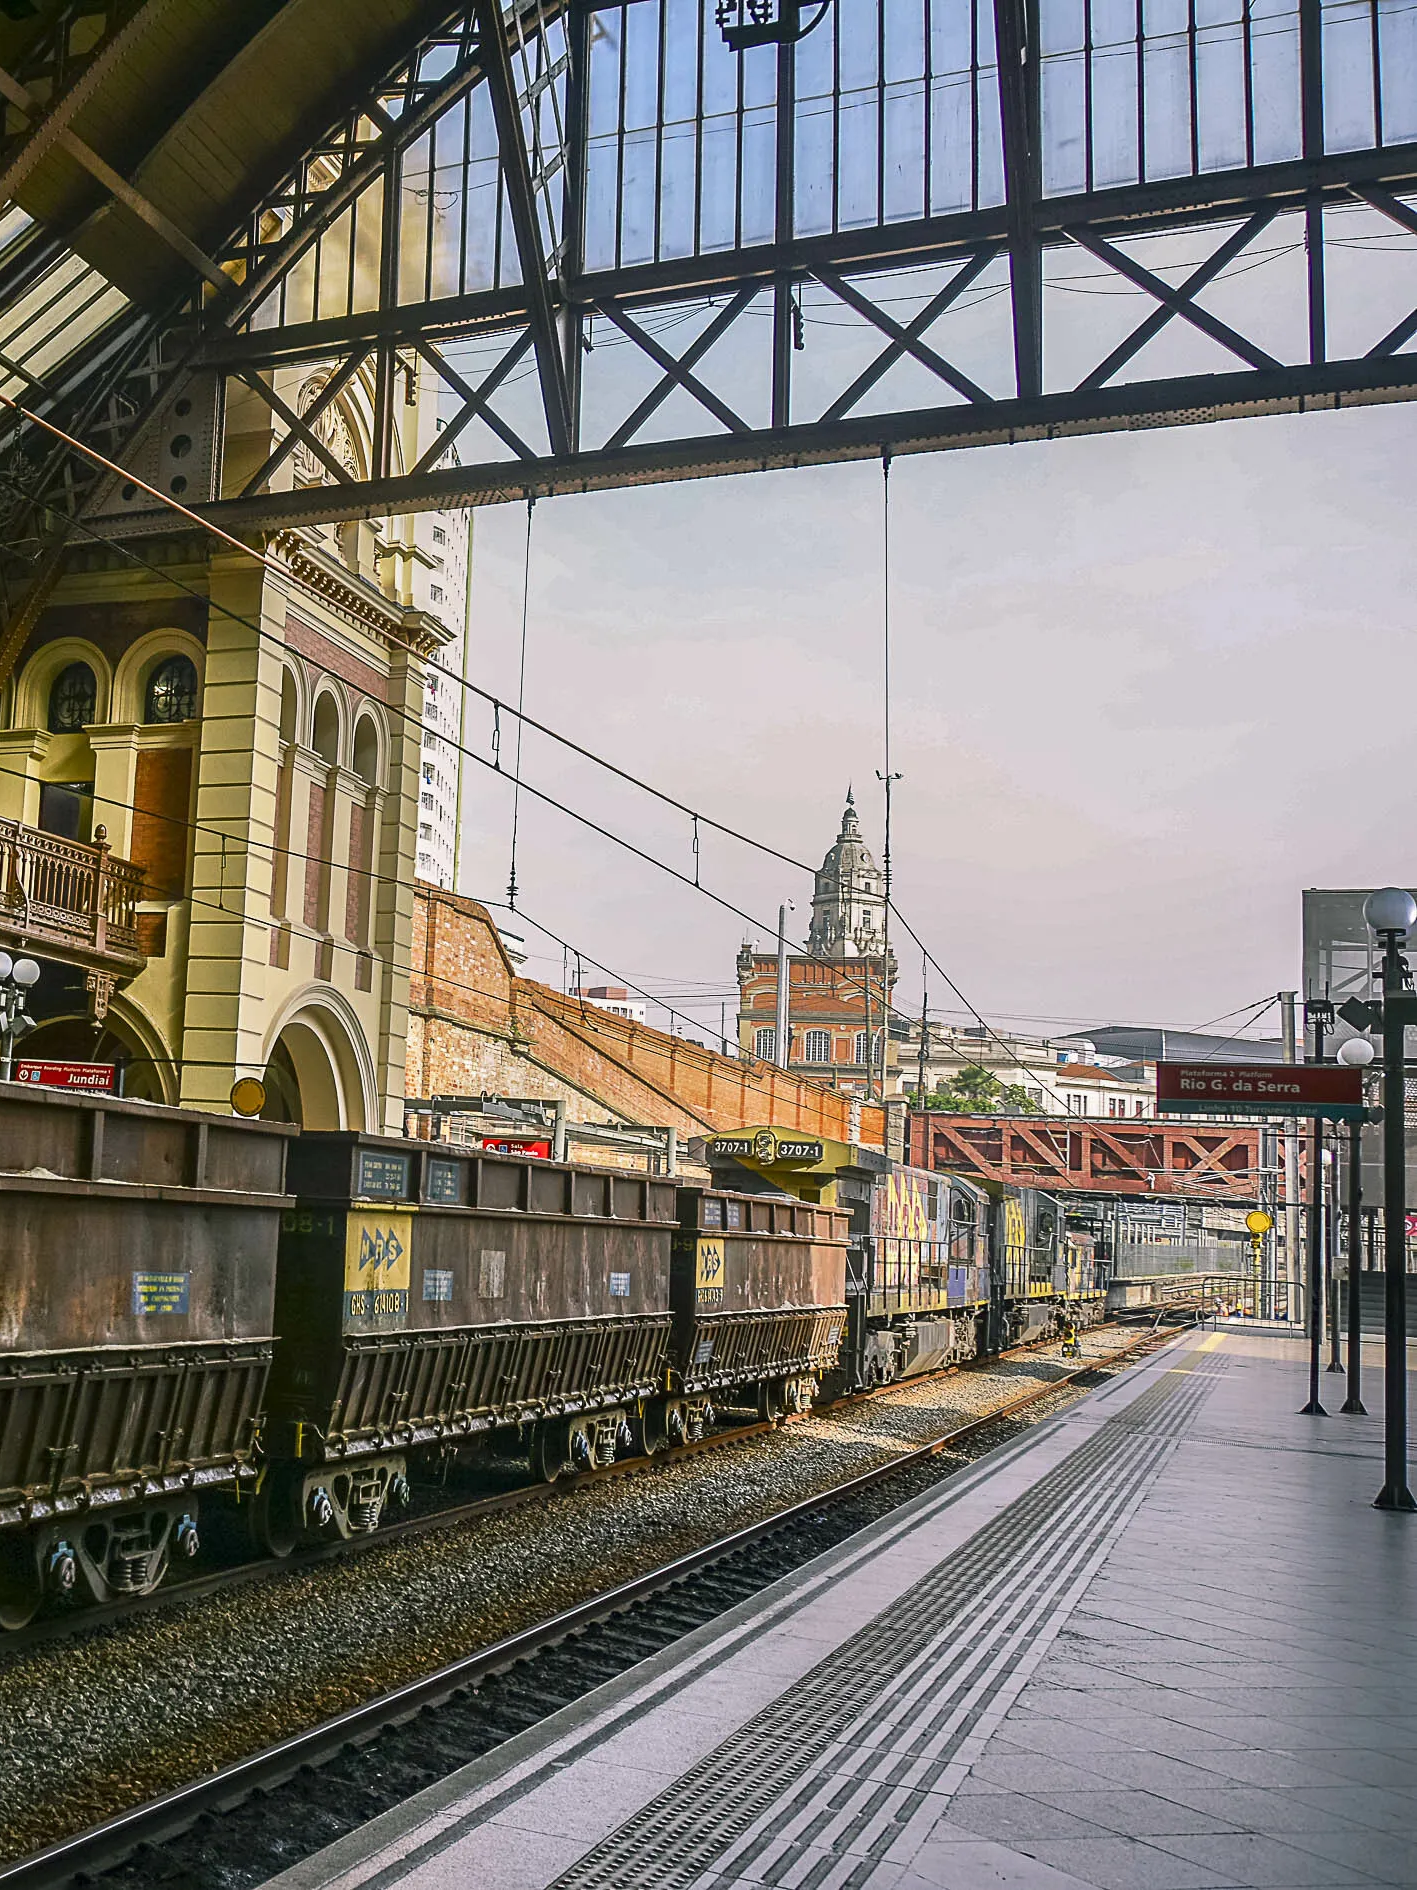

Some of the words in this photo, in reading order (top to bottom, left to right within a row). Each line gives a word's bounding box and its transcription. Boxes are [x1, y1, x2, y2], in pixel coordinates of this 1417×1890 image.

[67, 1073, 110, 1086] Jundiaí
[1180, 1078, 1206, 1090] Rio
[1211, 1080, 1227, 1091] G.
[1232, 1080, 1253, 1091] da
[1257, 1080, 1300, 1093] Serra
[714, 1142, 748, 1153] 3707-1
[780, 1144, 819, 1157] 3707-1
[361, 1239, 398, 1261] MRS
